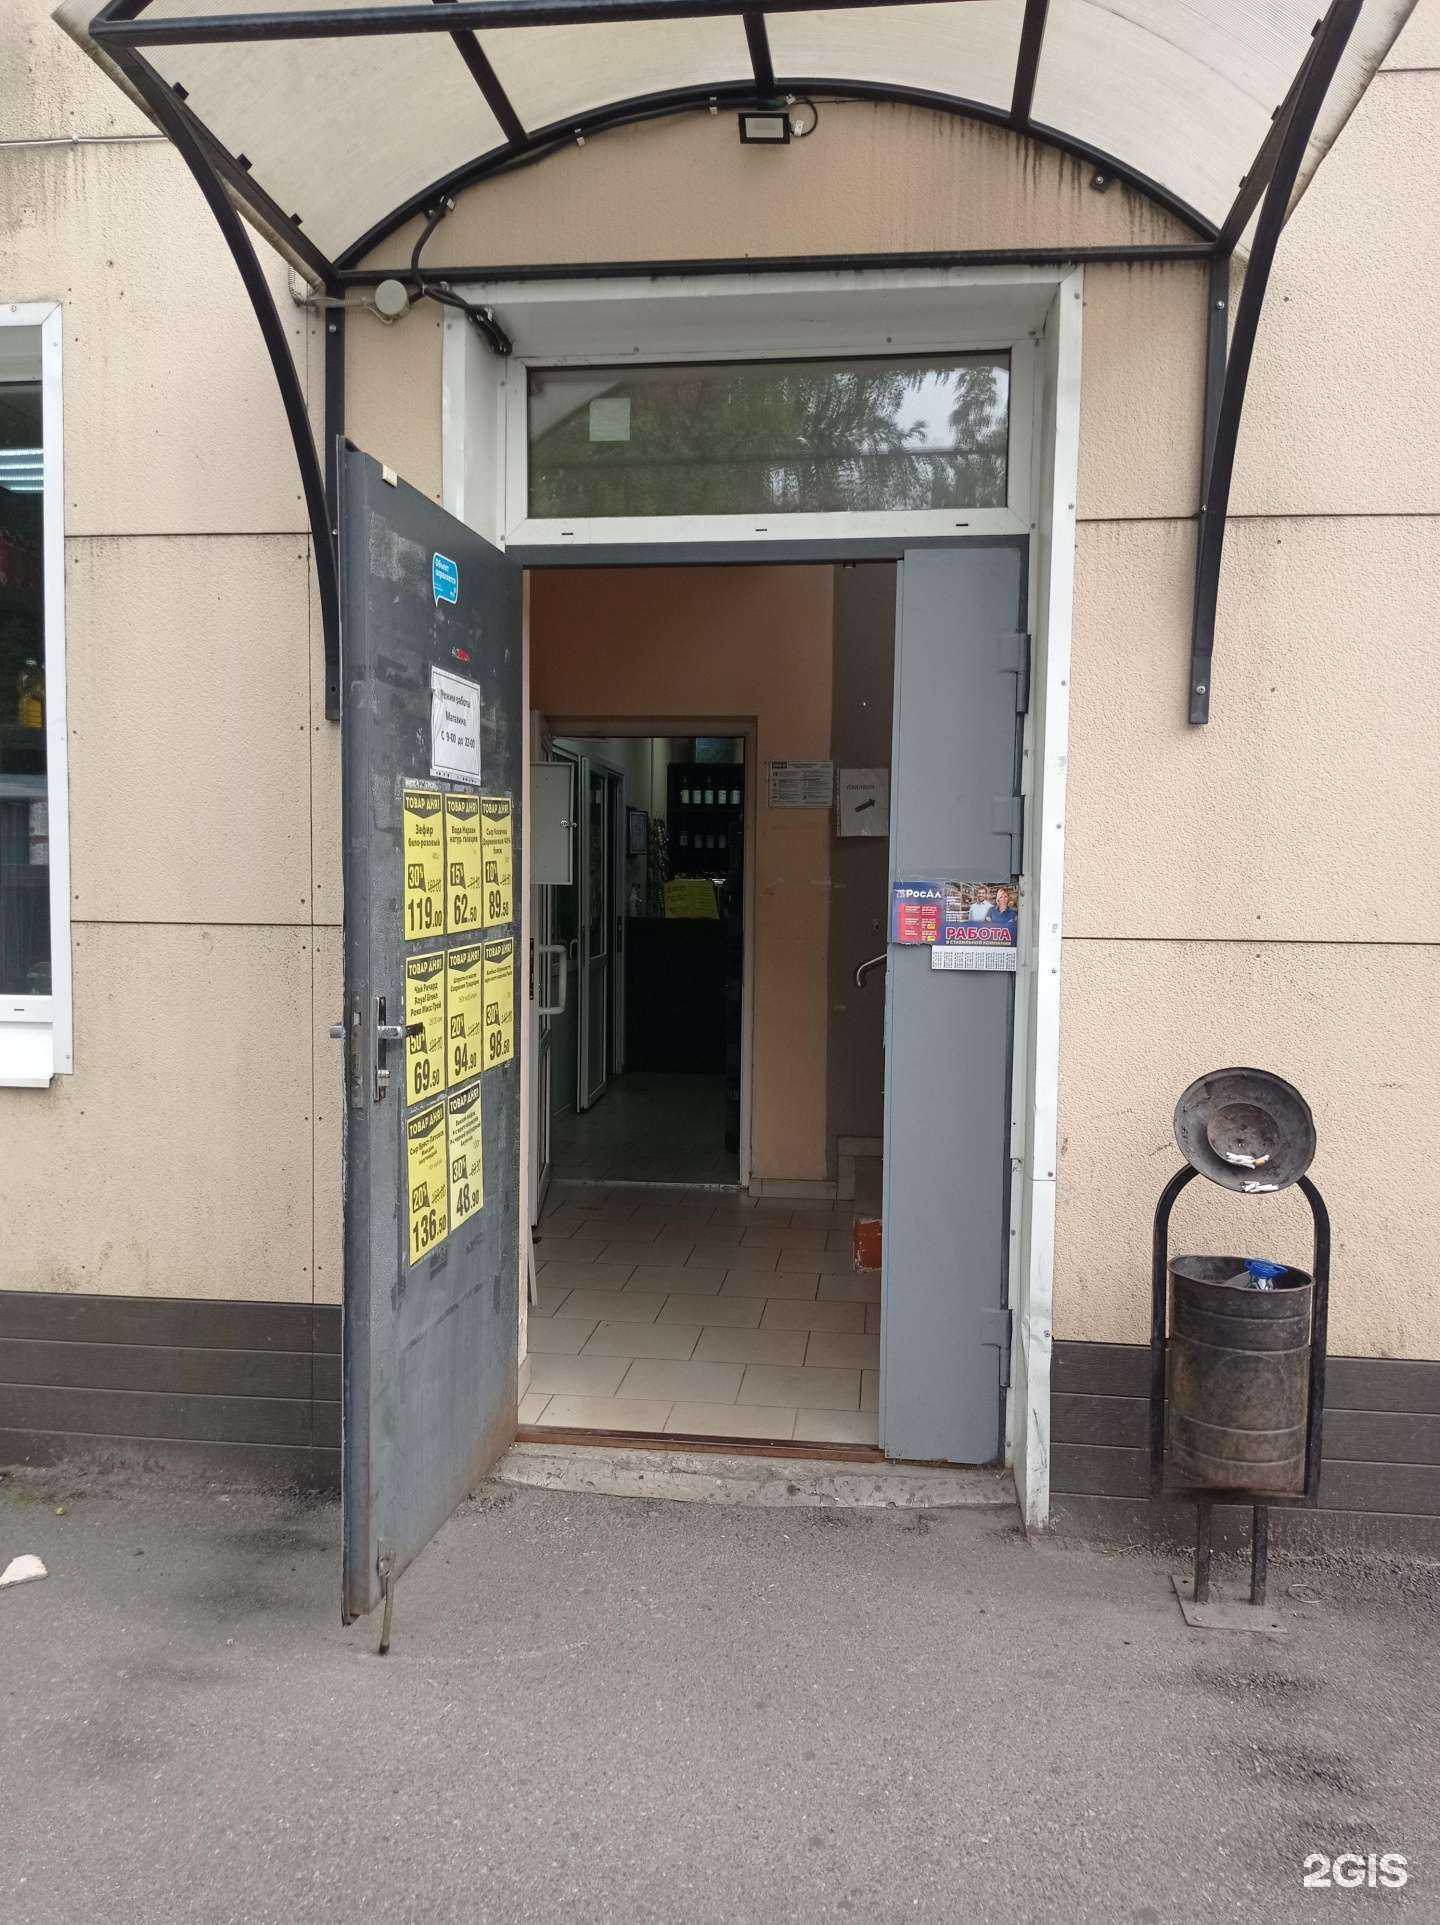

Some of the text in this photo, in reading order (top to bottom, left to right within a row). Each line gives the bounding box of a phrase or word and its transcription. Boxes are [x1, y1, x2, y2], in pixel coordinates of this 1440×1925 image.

[405, 796, 425, 809] ТОВАР
[447, 800, 465, 812] ТОВАР
[482, 803, 497, 814] ТОВАР
[415, 824, 434, 837] Зефир
[945, 926, 1011, 941] РАБОТА
[485, 946, 501, 958] ТОВАР
[449, 953, 467, 967] ТОВАР
[409, 961, 427, 976] ТОВАР
[450, 1095, 467, 1112] ТОВАР
[409, 1118, 429, 1137] ТОВАР
